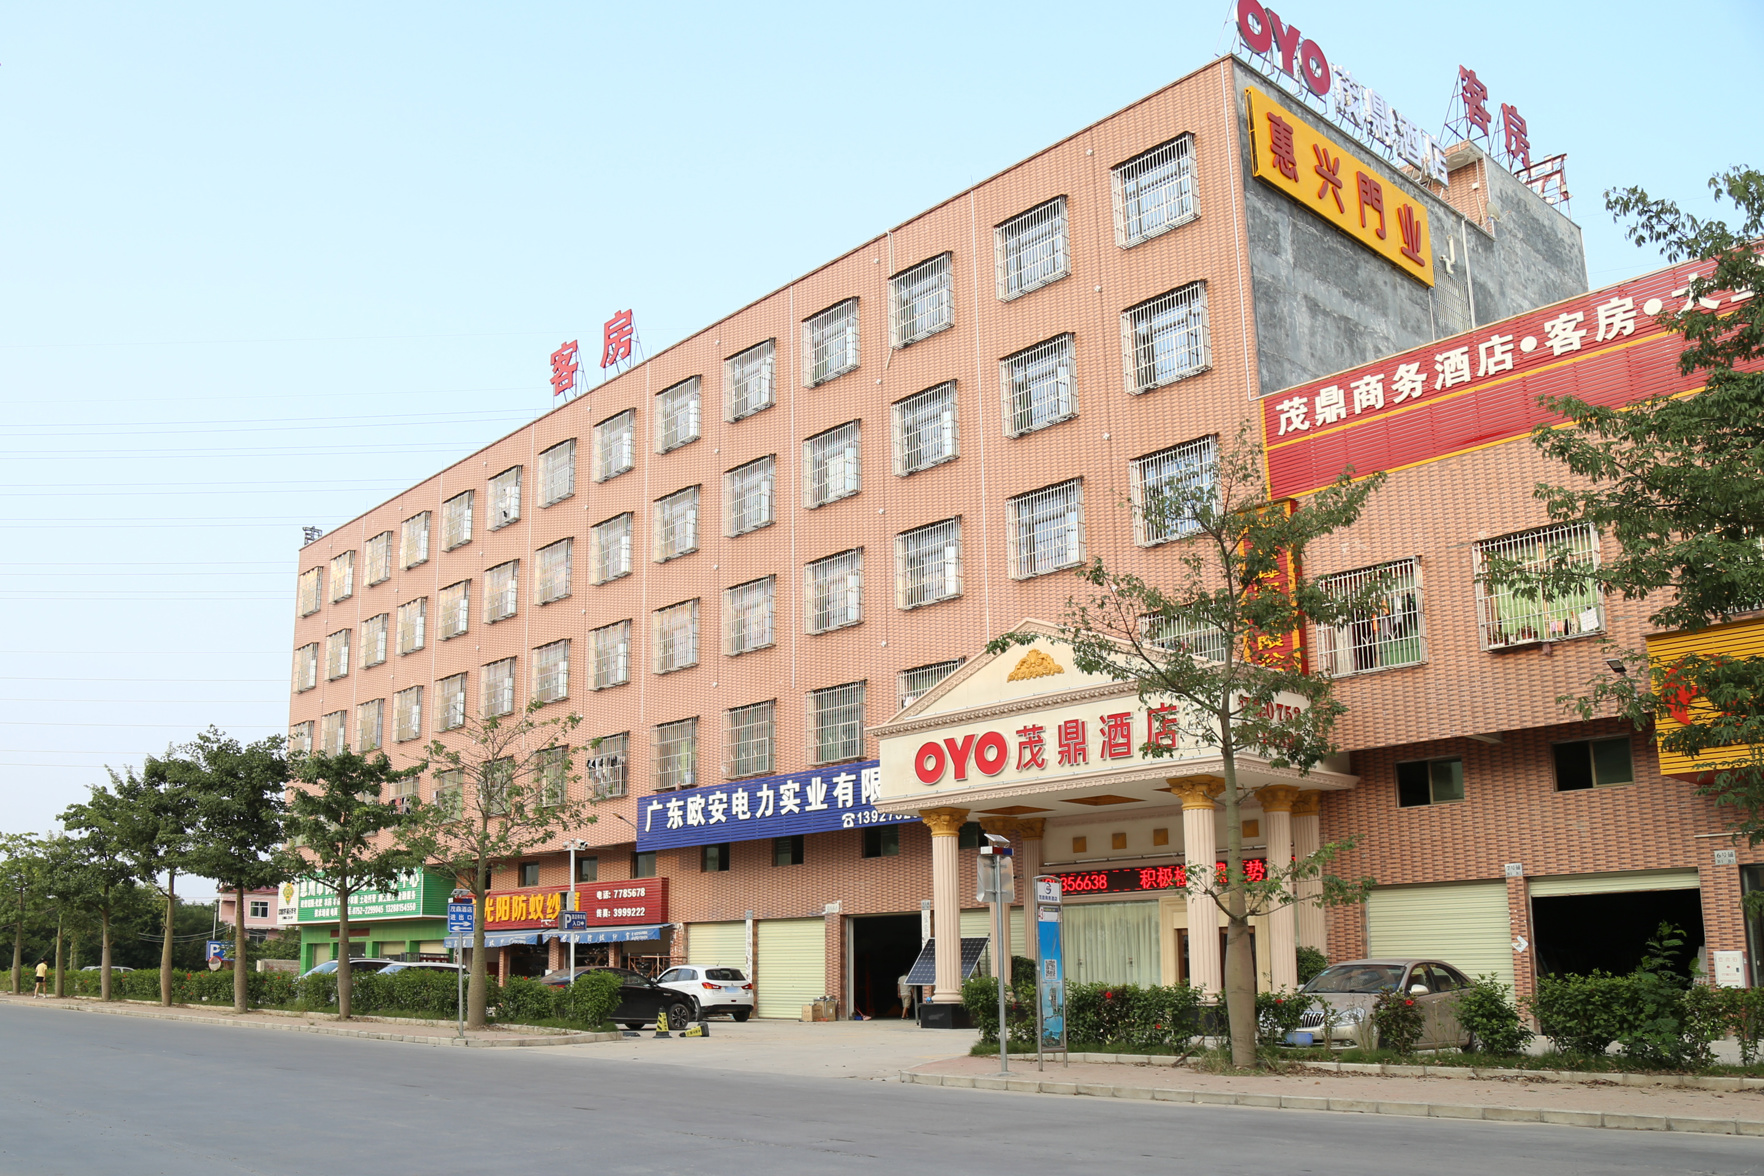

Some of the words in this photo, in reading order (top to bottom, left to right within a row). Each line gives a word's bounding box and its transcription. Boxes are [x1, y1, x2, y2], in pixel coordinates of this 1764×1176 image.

[1235, 0, 1332, 96] OYO
[1331, 64, 1449, 188] 茂鼎酒店
[1459, 64, 1530, 168] 客房
[549, 309, 633, 396] 客房
[914, 730, 1010, 785] OYO
[1016, 702, 1178, 771] 茂鼎酒店
[645, 767, 880, 832] 广东欧安电力实业有限
[473, 891, 580, 922] 光阳防蚊纱
[564, 913, 572, 929] P
[613, 887, 646, 899] 7785678
[613, 907, 646, 918] 3999222
